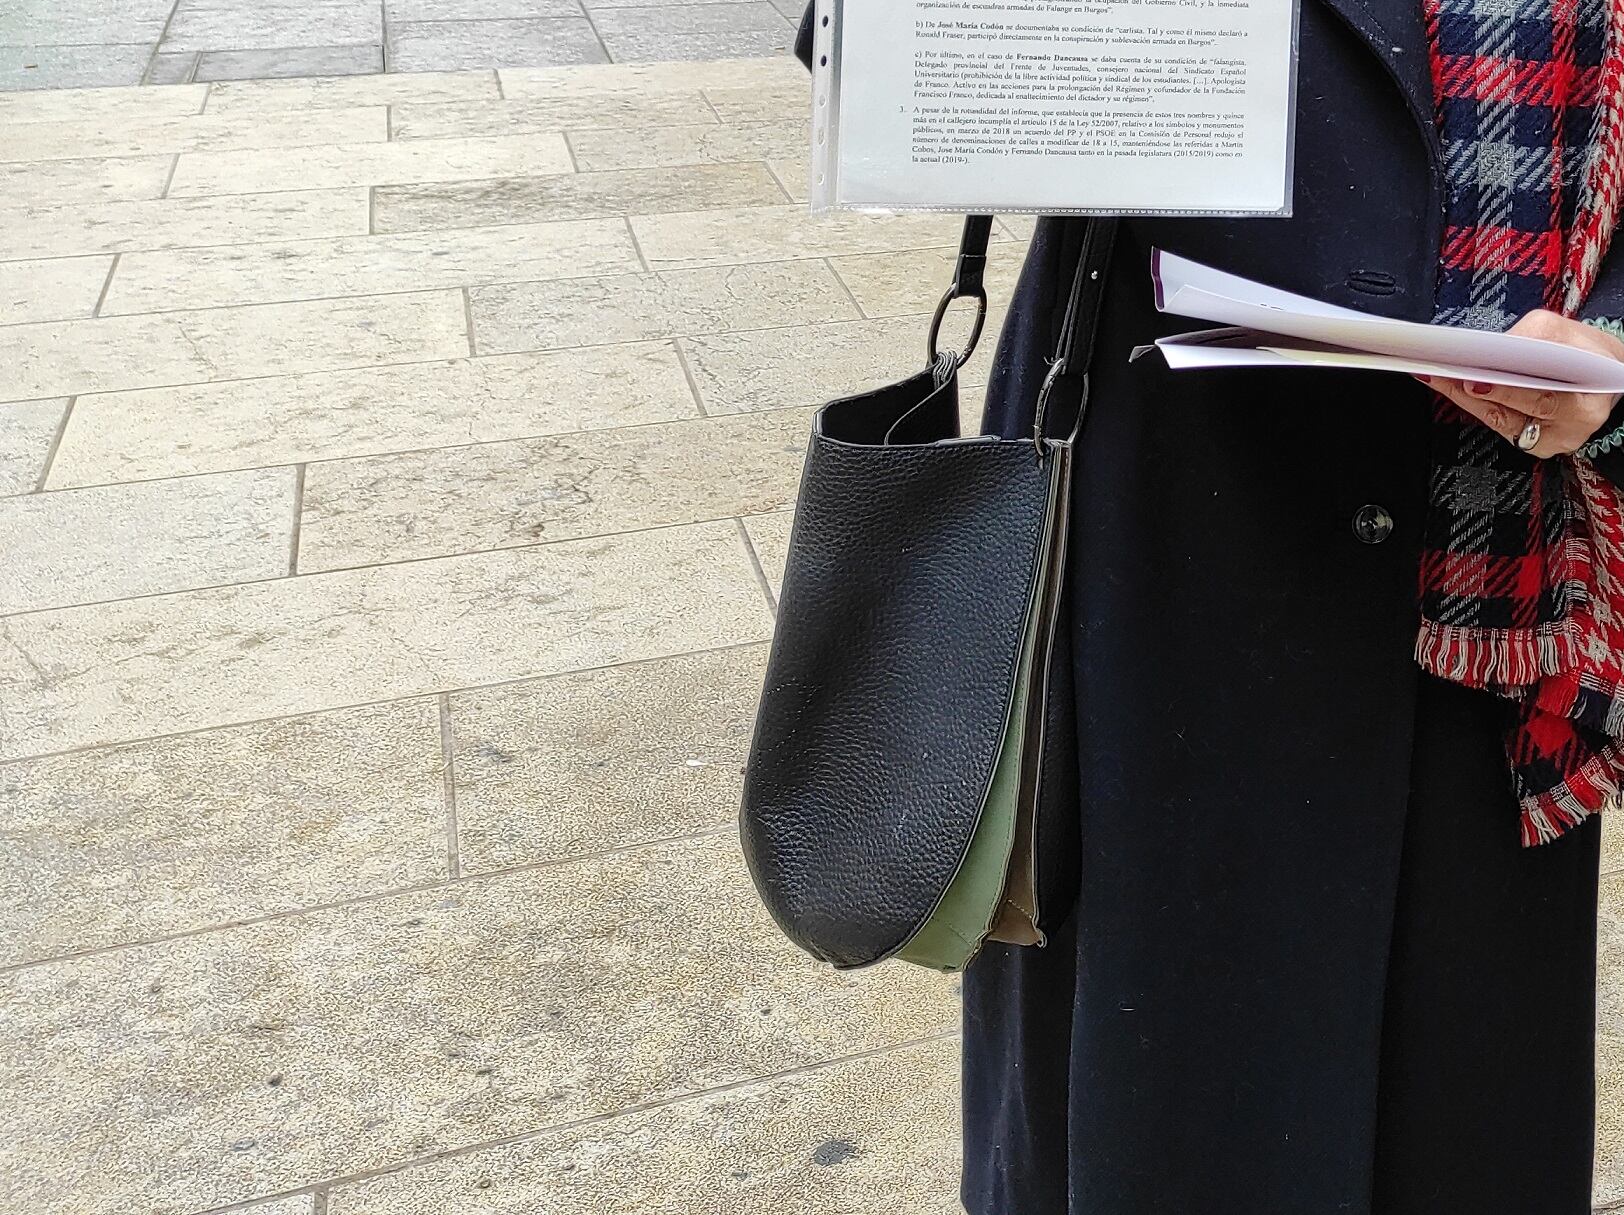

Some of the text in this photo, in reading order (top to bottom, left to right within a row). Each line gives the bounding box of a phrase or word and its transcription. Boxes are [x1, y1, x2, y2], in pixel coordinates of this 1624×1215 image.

[953, 81, 1191, 94] Activo cofundador
[914, 90, 1105, 102] Francisco dictador
[946, 116, 1120, 128] callejero 52/2007,
[1183, 130, 1212, 138] Personal
[920, 155, 941, 163] actual
[1138, 149, 1214, 159] legislatura (2015/2019)
